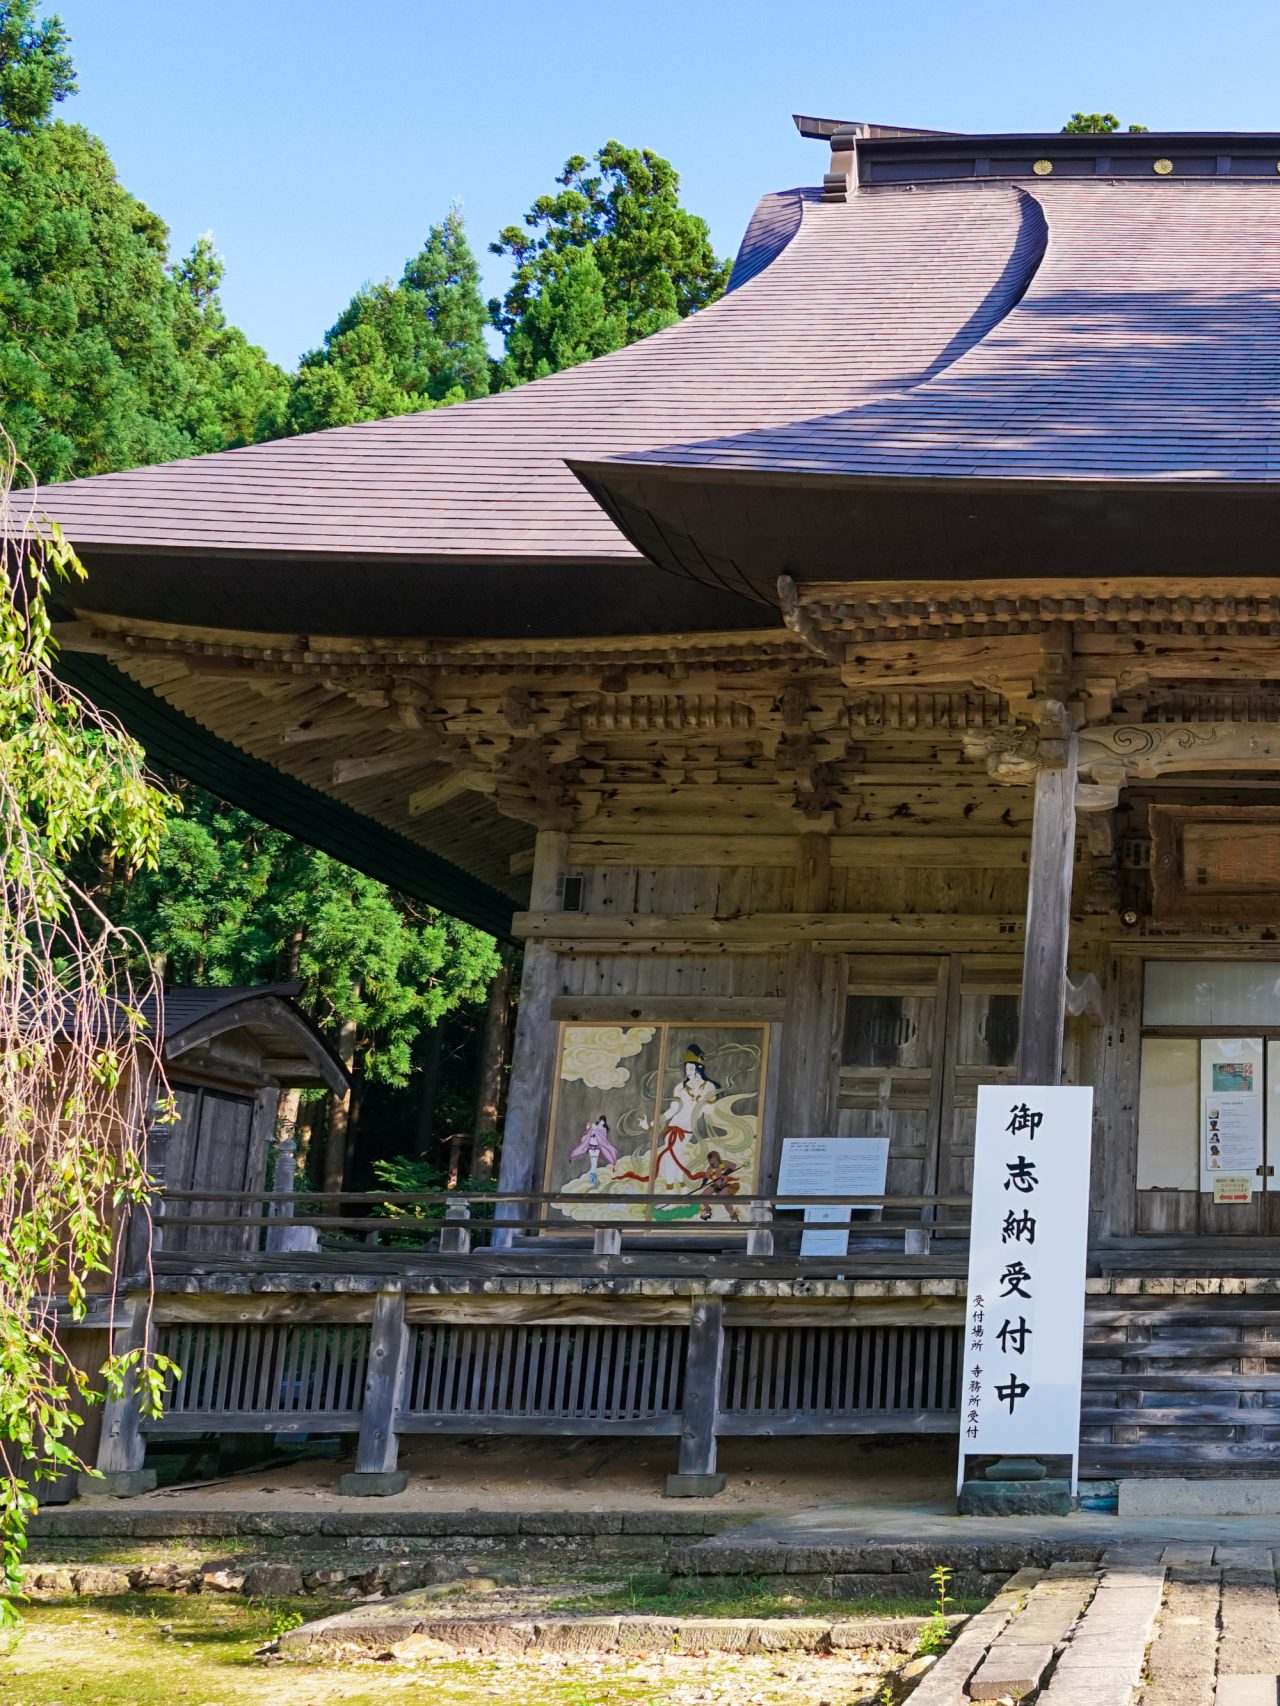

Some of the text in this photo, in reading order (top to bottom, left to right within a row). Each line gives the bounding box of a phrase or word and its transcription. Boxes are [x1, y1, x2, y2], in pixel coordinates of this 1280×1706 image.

[966, 1295, 985, 1439] 受付場所 寺務所受付
[994, 1103, 1043, 1415] 御志納受付中
